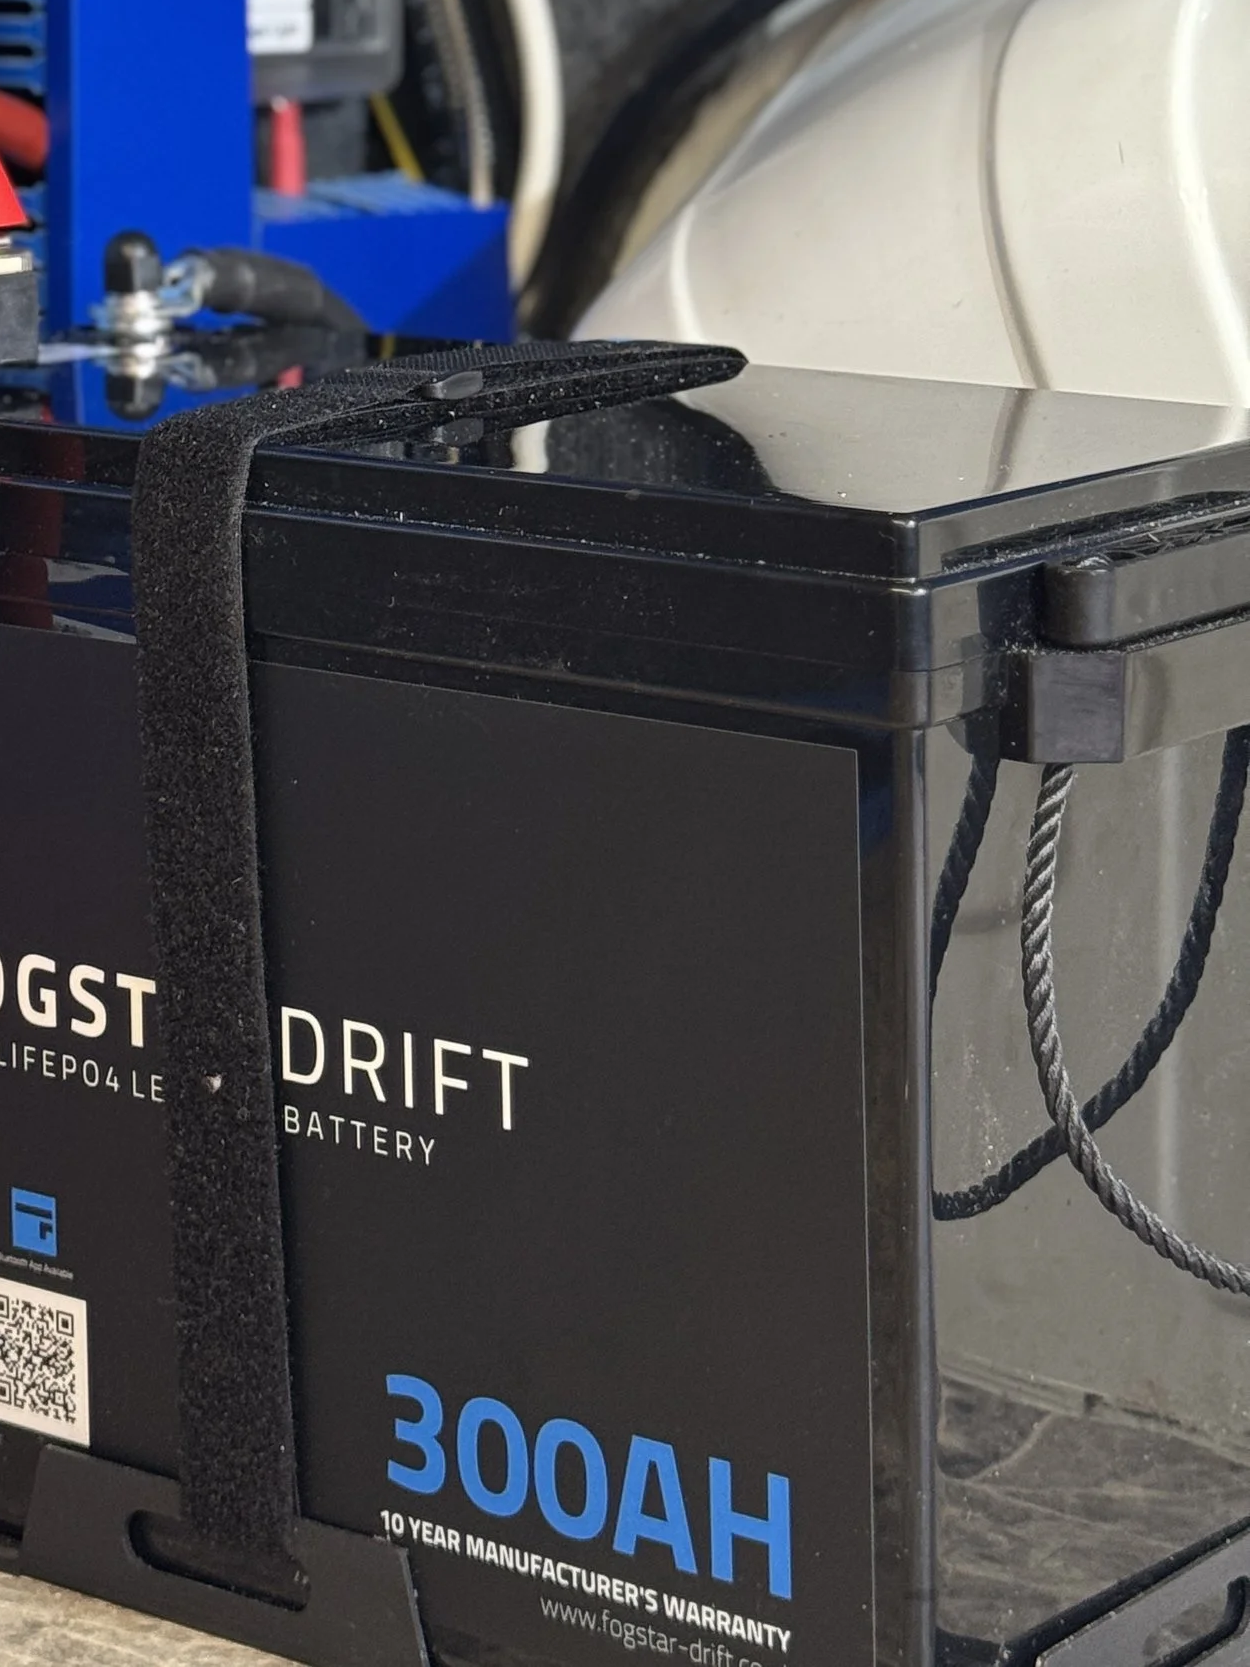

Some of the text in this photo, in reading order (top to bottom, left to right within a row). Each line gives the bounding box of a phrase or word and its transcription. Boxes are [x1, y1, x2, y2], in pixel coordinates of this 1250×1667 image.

[280, 1005, 530, 1132] DRIFT
[283, 1103, 437, 1167] BATTERY
[386, 1373, 793, 1601] 300AH
[380, 1509, 791, 1654] 10 YEAR MANUFACTURER'S WARRANTY
